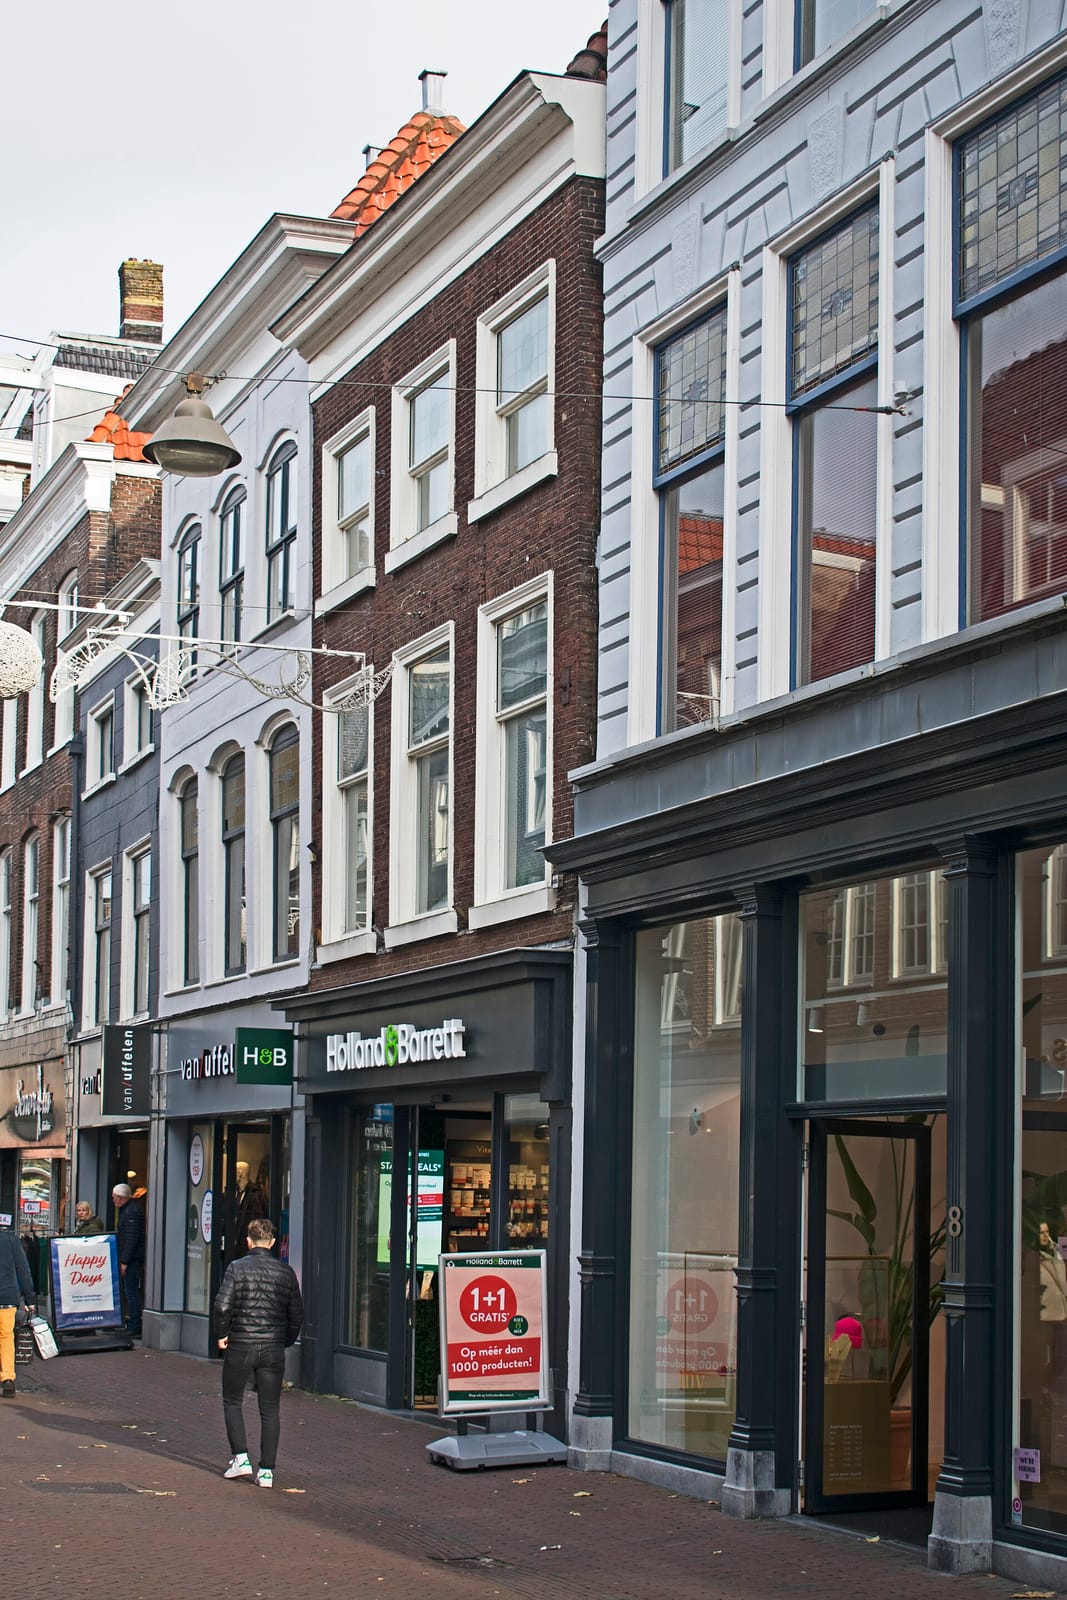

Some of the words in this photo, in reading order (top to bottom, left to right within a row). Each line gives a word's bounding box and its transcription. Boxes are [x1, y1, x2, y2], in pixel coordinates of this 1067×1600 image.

[243, 1046, 287, 1066] H&B
[948, 1206, 962, 1238] 8
[64, 1252, 107, 1270] Happy
[70, 1271, 104, 1287] Days
[470, 1287, 506, 1311] 1+1
[460, 1347, 477, 1361] Op
[479, 1345, 503, 1357] méér
[505, 1343, 523, 1355] dan
[451, 1361, 479, 1373] 1000
[481, 1356, 533, 1375] producten!
